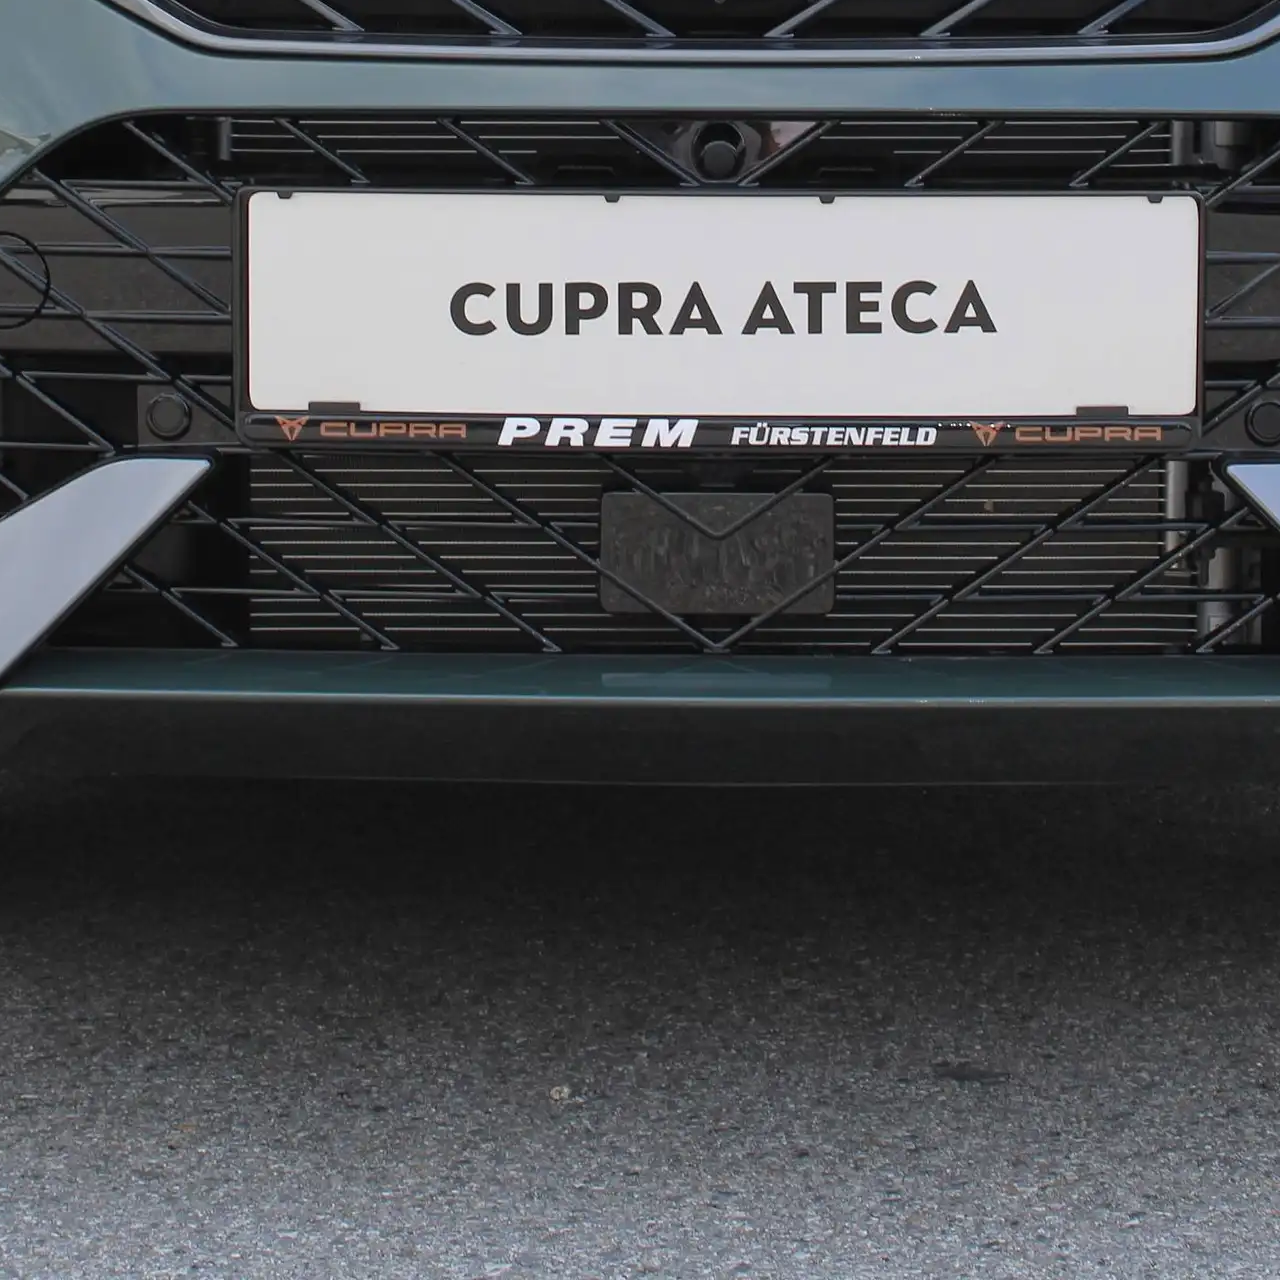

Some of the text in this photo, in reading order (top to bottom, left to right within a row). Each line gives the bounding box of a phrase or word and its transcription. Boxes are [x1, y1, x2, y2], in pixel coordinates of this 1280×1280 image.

[449, 279, 998, 336] CUPRA ATECA
[319, 417, 1163, 448] CUPRA PREM FÜRSTENFELD CUPRA
